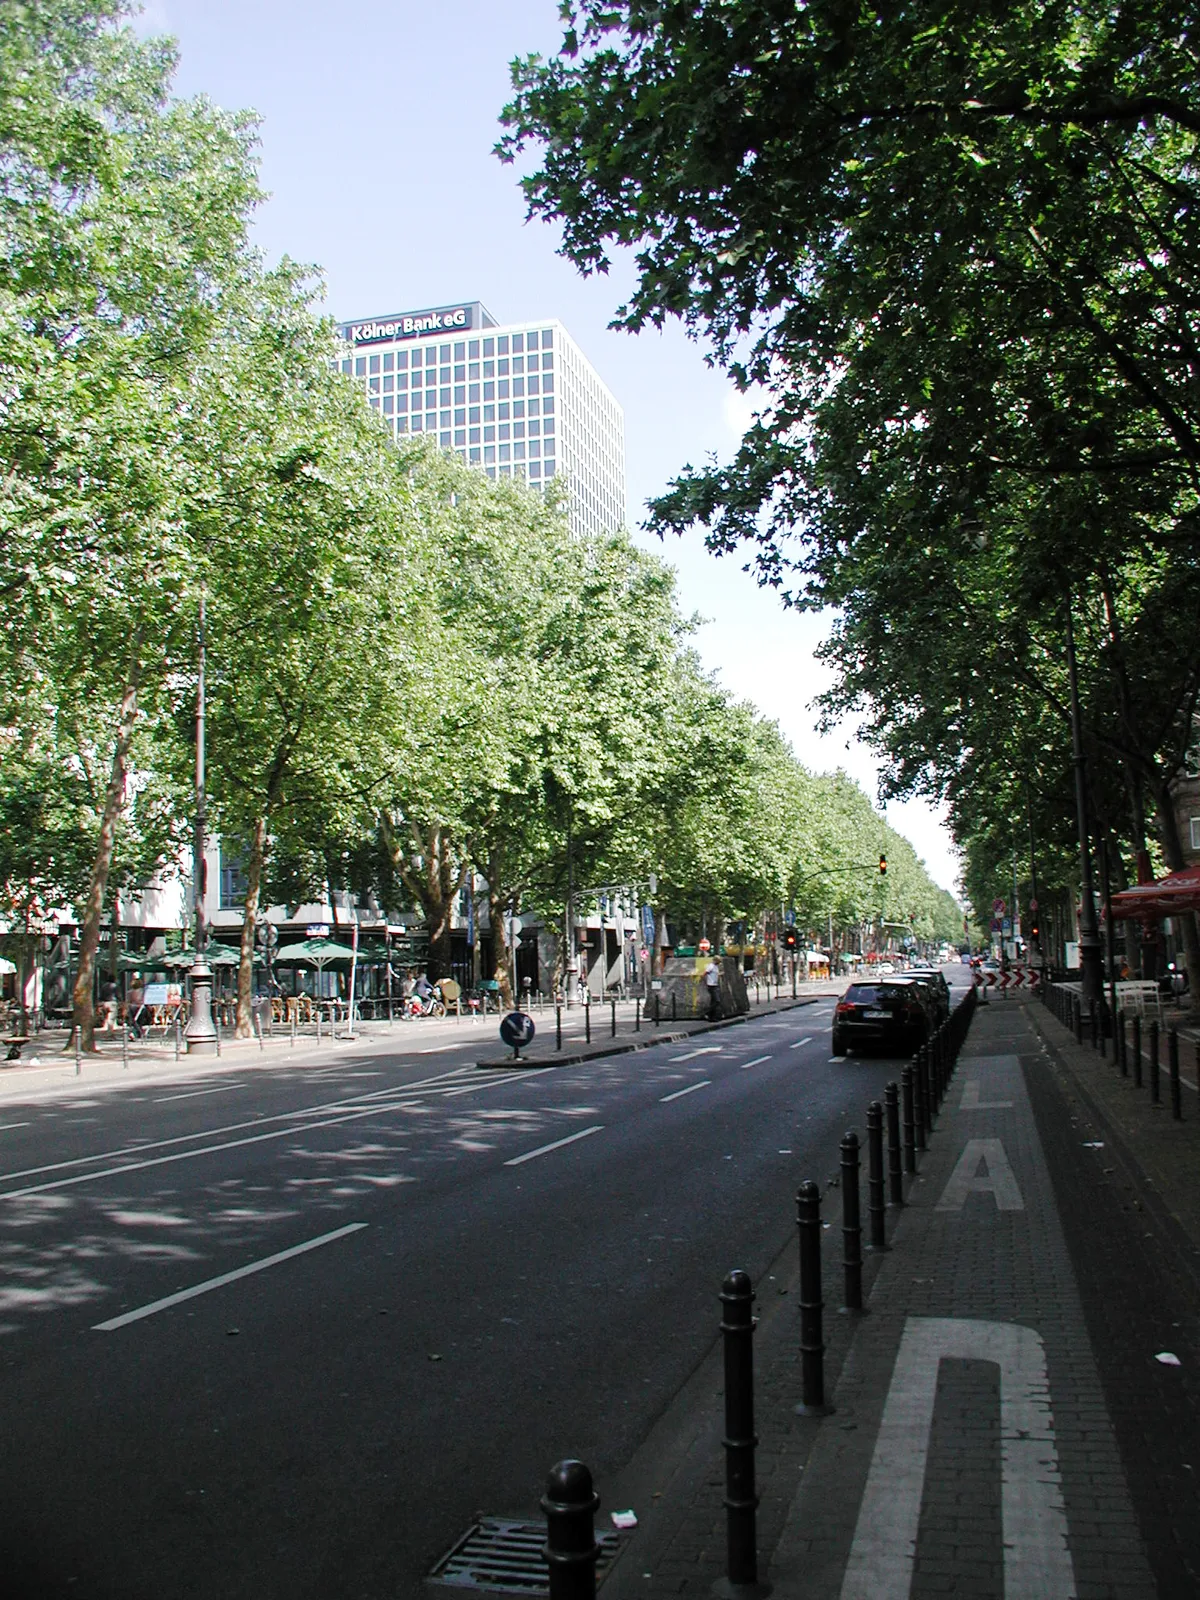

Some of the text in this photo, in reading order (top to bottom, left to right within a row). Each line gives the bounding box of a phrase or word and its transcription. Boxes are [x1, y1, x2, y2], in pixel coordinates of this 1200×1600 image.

[351, 310, 466, 341] Kölner Bank eG
